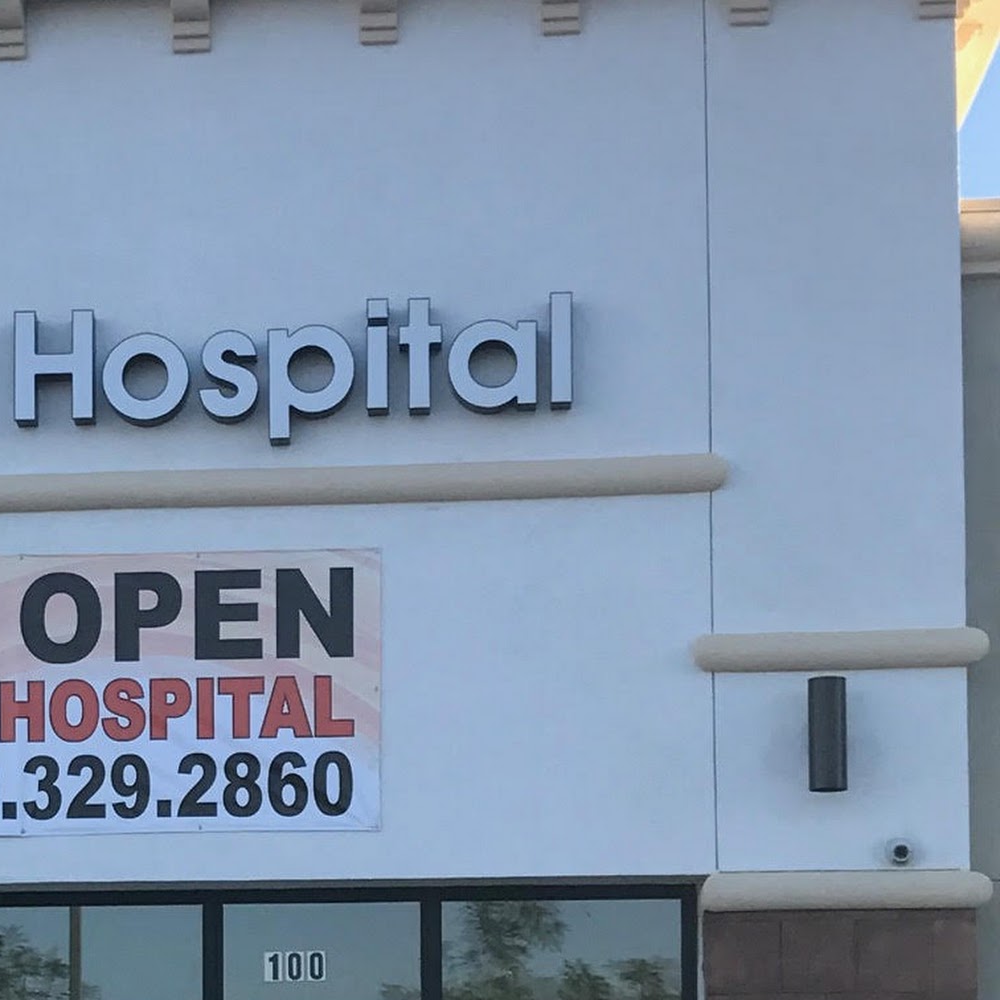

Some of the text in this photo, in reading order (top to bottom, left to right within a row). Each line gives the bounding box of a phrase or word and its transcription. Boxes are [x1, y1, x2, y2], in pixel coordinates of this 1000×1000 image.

[12, 291, 573, 446] Hospital
[19, 567, 354, 665] OPEN
[268, 952, 324, 980] 100
